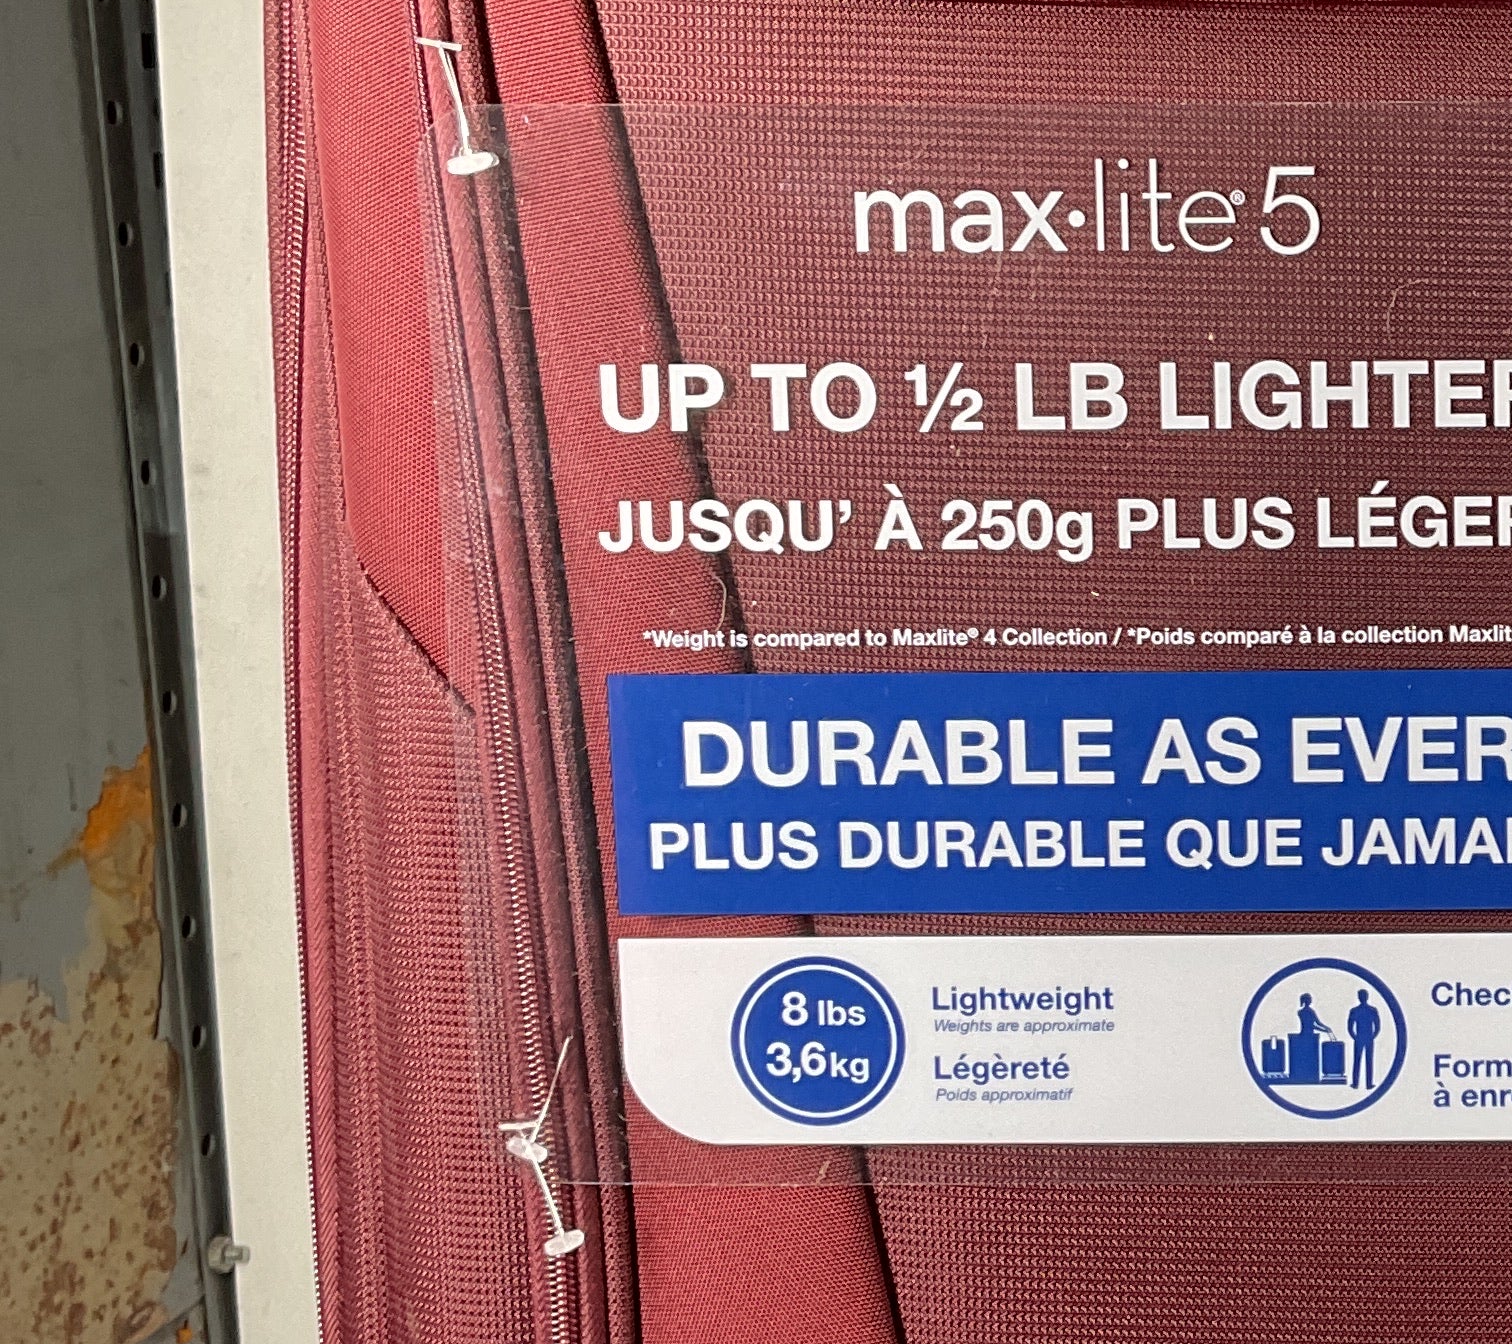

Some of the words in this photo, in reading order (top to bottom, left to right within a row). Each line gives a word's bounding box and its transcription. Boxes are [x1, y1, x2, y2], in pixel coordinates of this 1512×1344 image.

[598, 363, 725, 434] UP
[750, 361, 877, 434] TO
[1015, 362, 1128, 431] LB
[875, 483, 924, 551] À
[940, 498, 1094, 563] 250g
[1117, 496, 1295, 550] PLUS
[729, 629, 749, 648] is
[752, 628, 860, 651] compared
[864, 629, 887, 647] to
[982, 628, 998, 646] 4
[1001, 627, 1108, 646] Collection
[1200, 624, 1294, 649] comparé
[1298, 624, 1312, 644] à
[1317, 625, 1336, 644] la
[1341, 625, 1444, 644] collection
[682, 719, 1115, 788] DURABLE
[1141, 716, 1261, 785] AS
[649, 820, 819, 870] PLUS
[839, 820, 1146, 869] DURABLE
[1165, 818, 1303, 870] QUE
[781, 991, 809, 1027] 8
[817, 999, 866, 1026] lbs
[932, 986, 1114, 1017] Lightweight
[934, 1019, 993, 1035] Weights
[996, 1022, 1020, 1032] are
[1023, 1019, 1115, 1035] approximate
[934, 1053, 1070, 1086] Légèreté
[935, 1087, 977, 1102] Poids
[981, 1087, 1074, 1104] approximatif
[1433, 1081, 1451, 1108] à
